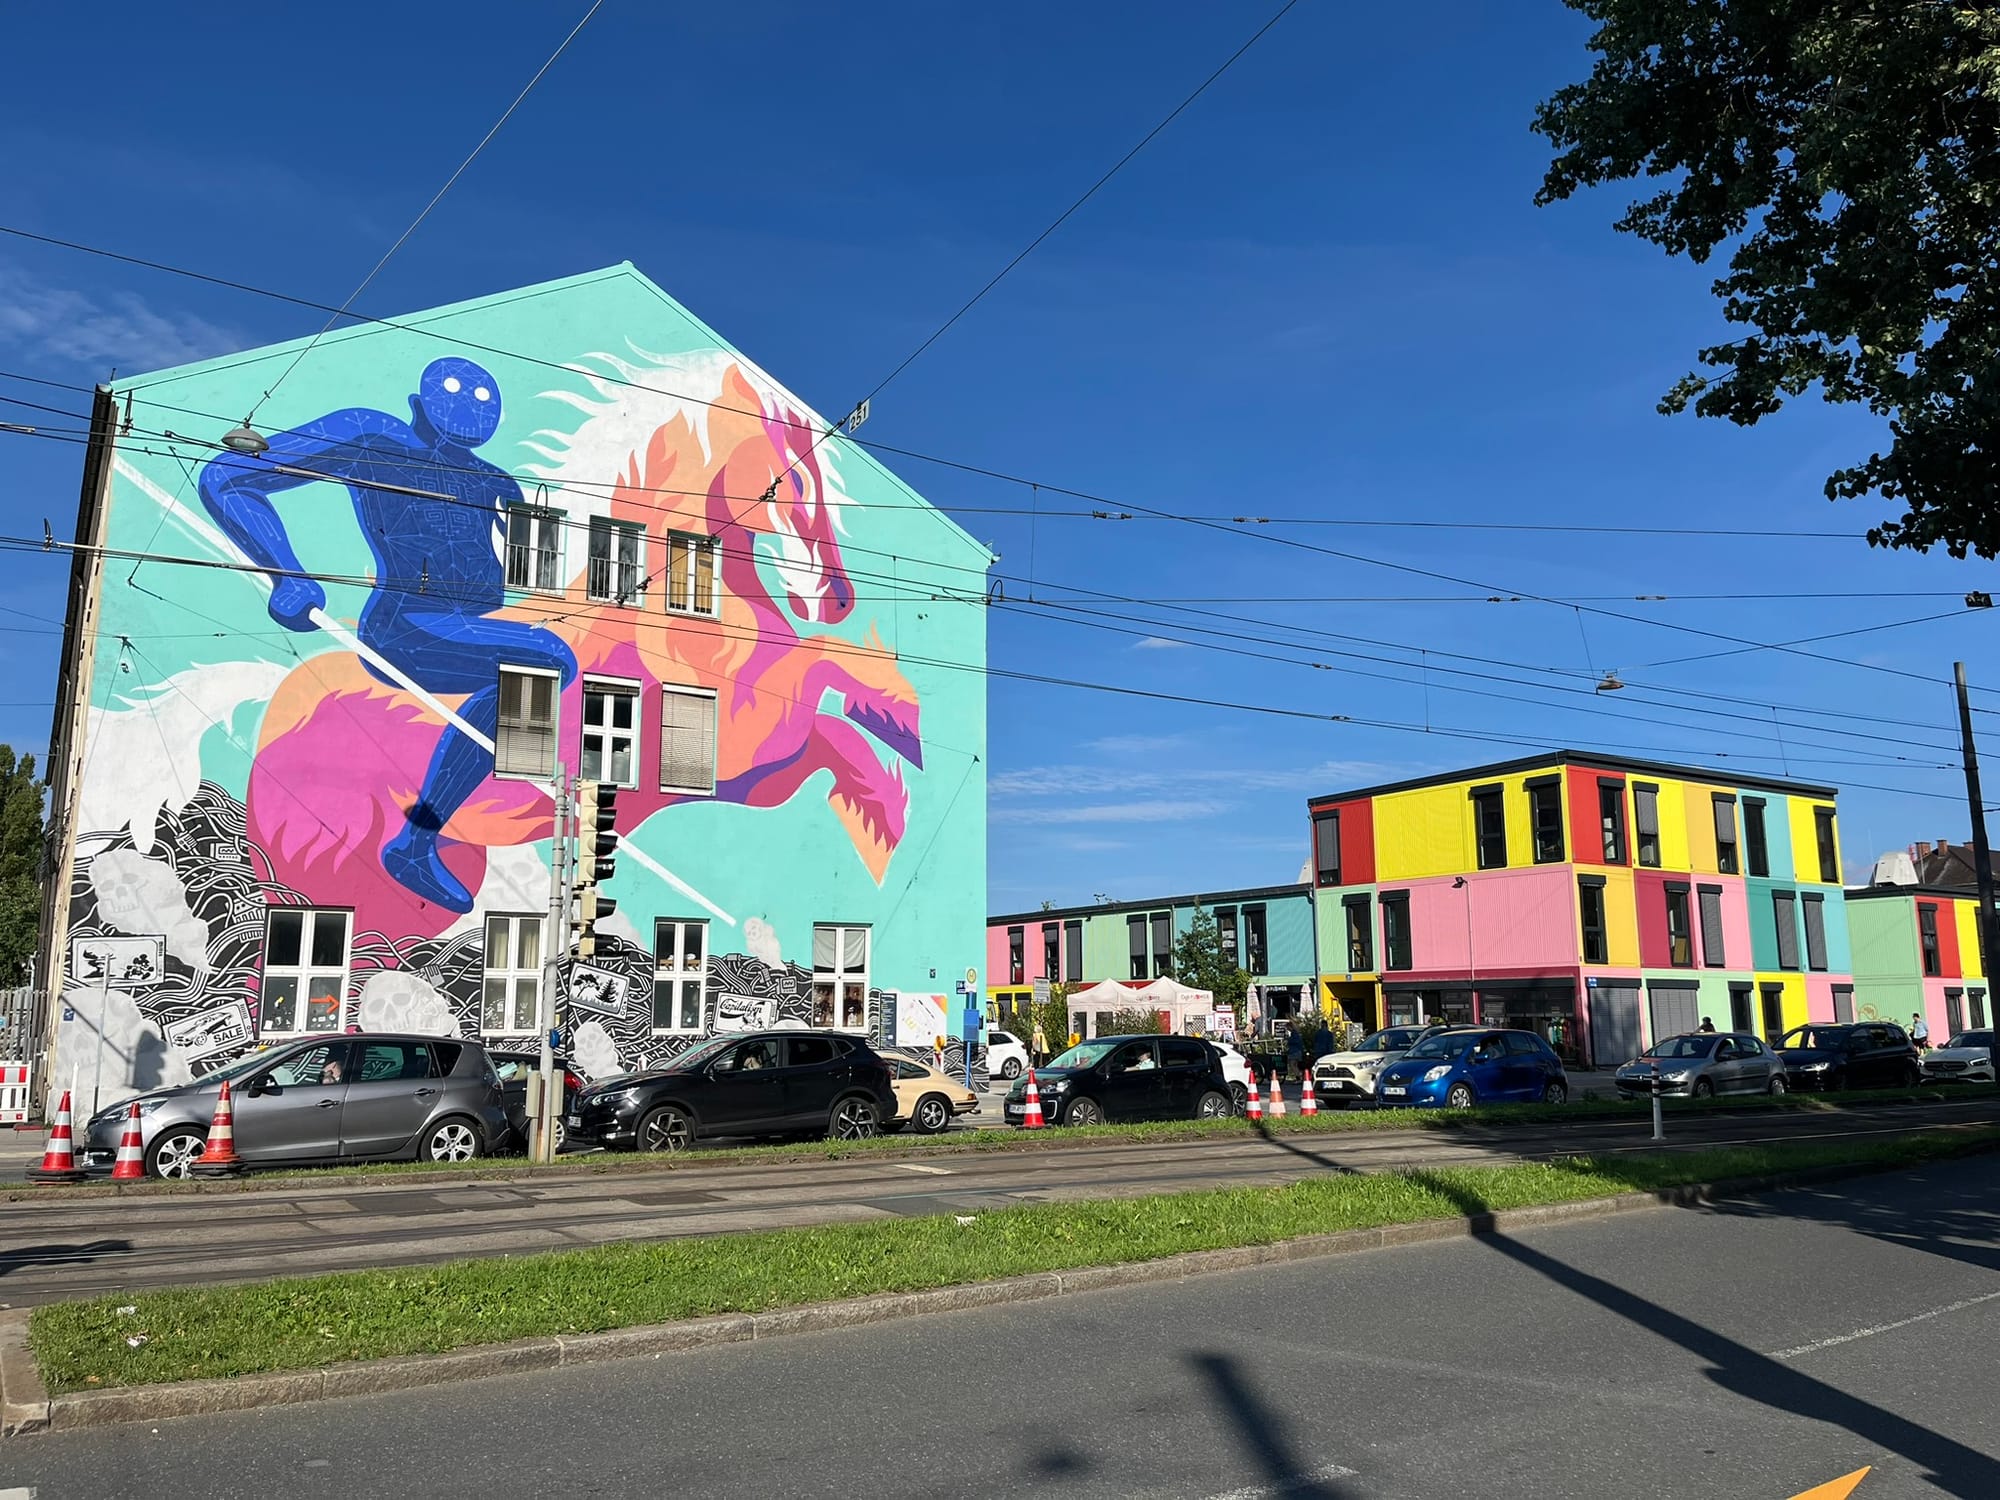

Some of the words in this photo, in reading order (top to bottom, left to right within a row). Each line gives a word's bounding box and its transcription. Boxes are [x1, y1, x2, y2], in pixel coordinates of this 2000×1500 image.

[850, 406, 867, 431] 251
[720, 998, 762, 1015] Capitalism
[213, 1026, 244, 1043] SALE
